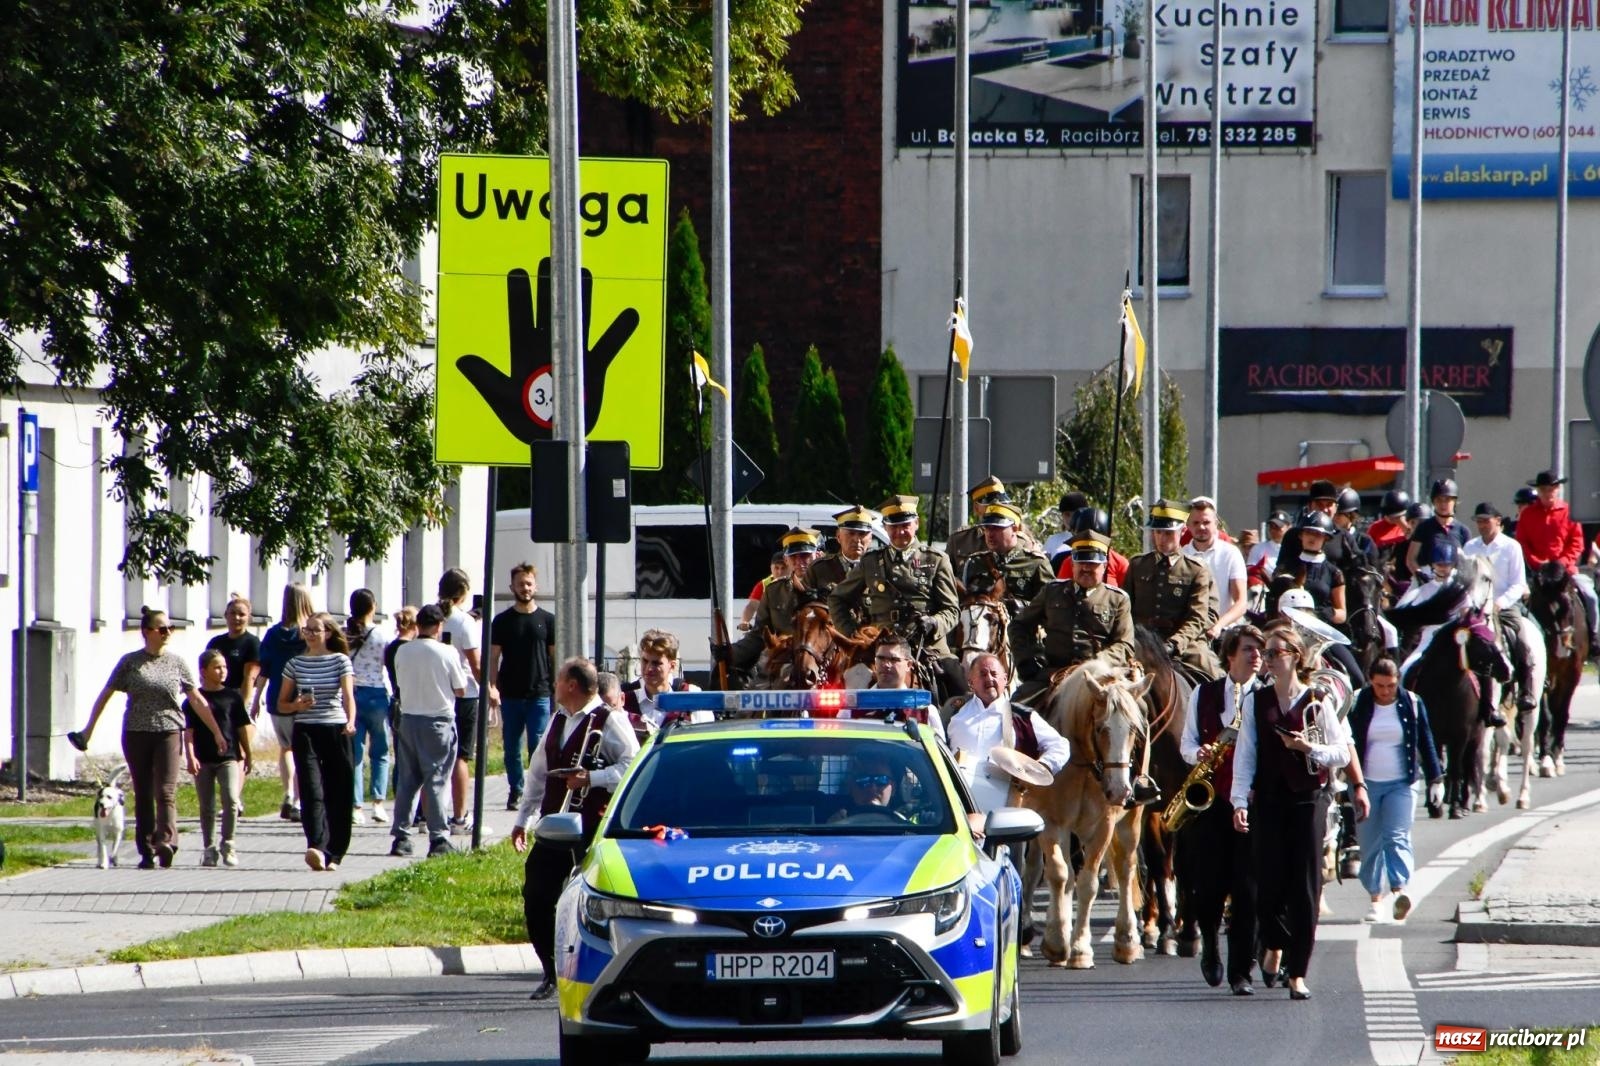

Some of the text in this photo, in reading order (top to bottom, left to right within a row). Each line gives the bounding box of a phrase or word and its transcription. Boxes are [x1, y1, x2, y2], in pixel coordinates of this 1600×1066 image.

[1155, 1, 1298, 27] Kuchnie
[1487, 0, 1600, 32] KLIMA
[1200, 40, 1298, 73] Szafy
[1423, 49, 1515, 63] ORADZTWO
[1423, 66, 1490, 82] PRZEDAŻ
[1423, 107, 1470, 120] ERWIS
[911, 129, 932, 143] ul.
[1024, 129, 1049, 145] 52,
[1061, 128, 1140, 143] Racibórz
[1159, 128, 1180, 142] el.
[1225, 127, 1256, 142] 332
[1263, 127, 1297, 142] 285
[1424, 126, 1529, 139] HŁODNICTWO
[1583, 163, 1600, 181] 6
[1248, 363, 1392, 387] RACIBORSKI
[741, 692, 813, 709] POLICJA
[687, 862, 854, 884] POLICJA
[720, 954, 829, 978] HPP R204
